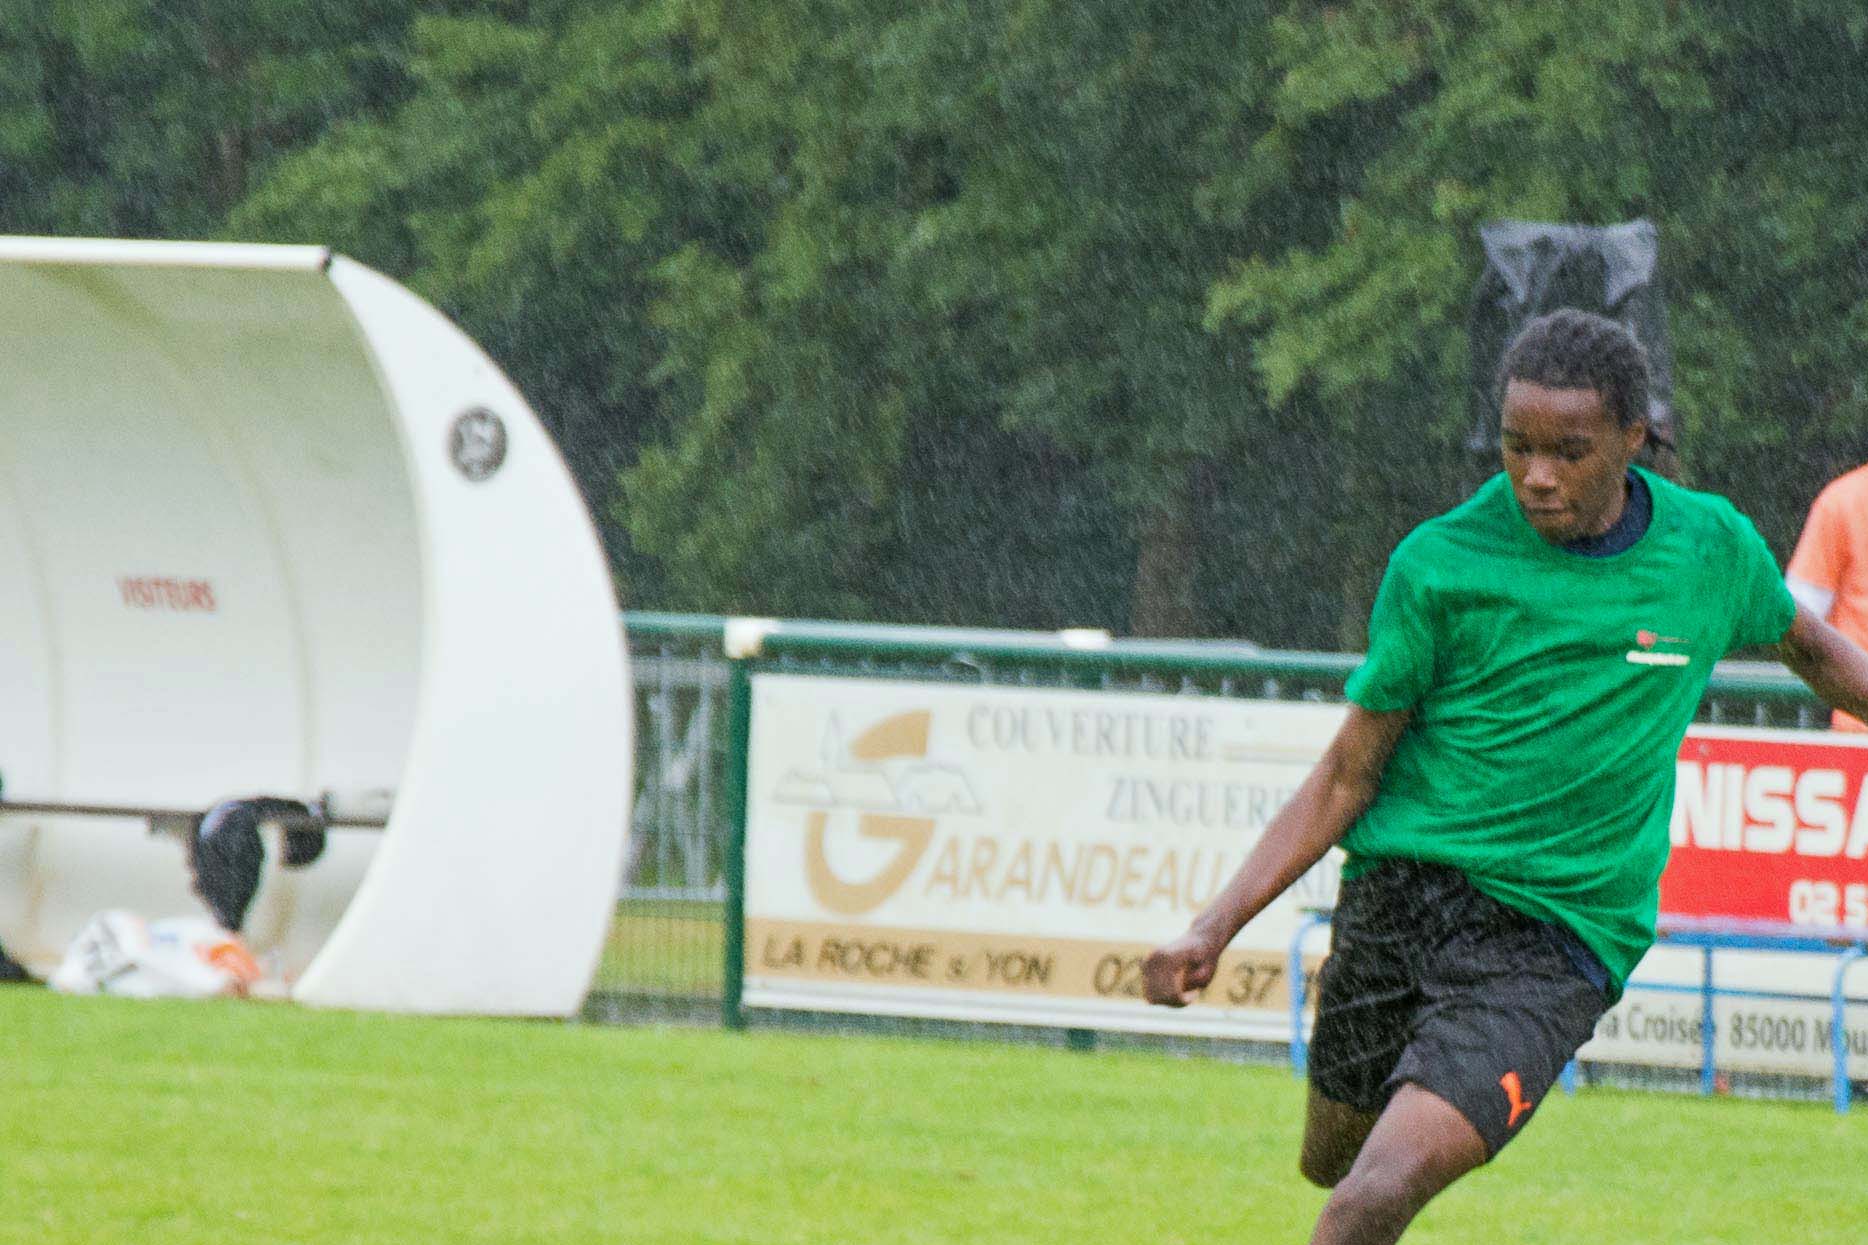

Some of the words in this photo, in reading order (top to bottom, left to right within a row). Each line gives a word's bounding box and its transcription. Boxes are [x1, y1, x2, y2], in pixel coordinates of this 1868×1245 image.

[966, 705, 1214, 761] COUVERTURE
[1105, 776, 1302, 831] ZINGUERI
[1789, 879, 1839, 927] 02
[762, 936, 802, 968] LA
[817, 937, 936, 977] ROCHE
[985, 952, 1055, 985] YON
[1226, 962, 1282, 1004] 37
[1730, 1011, 1808, 1052] 85000
